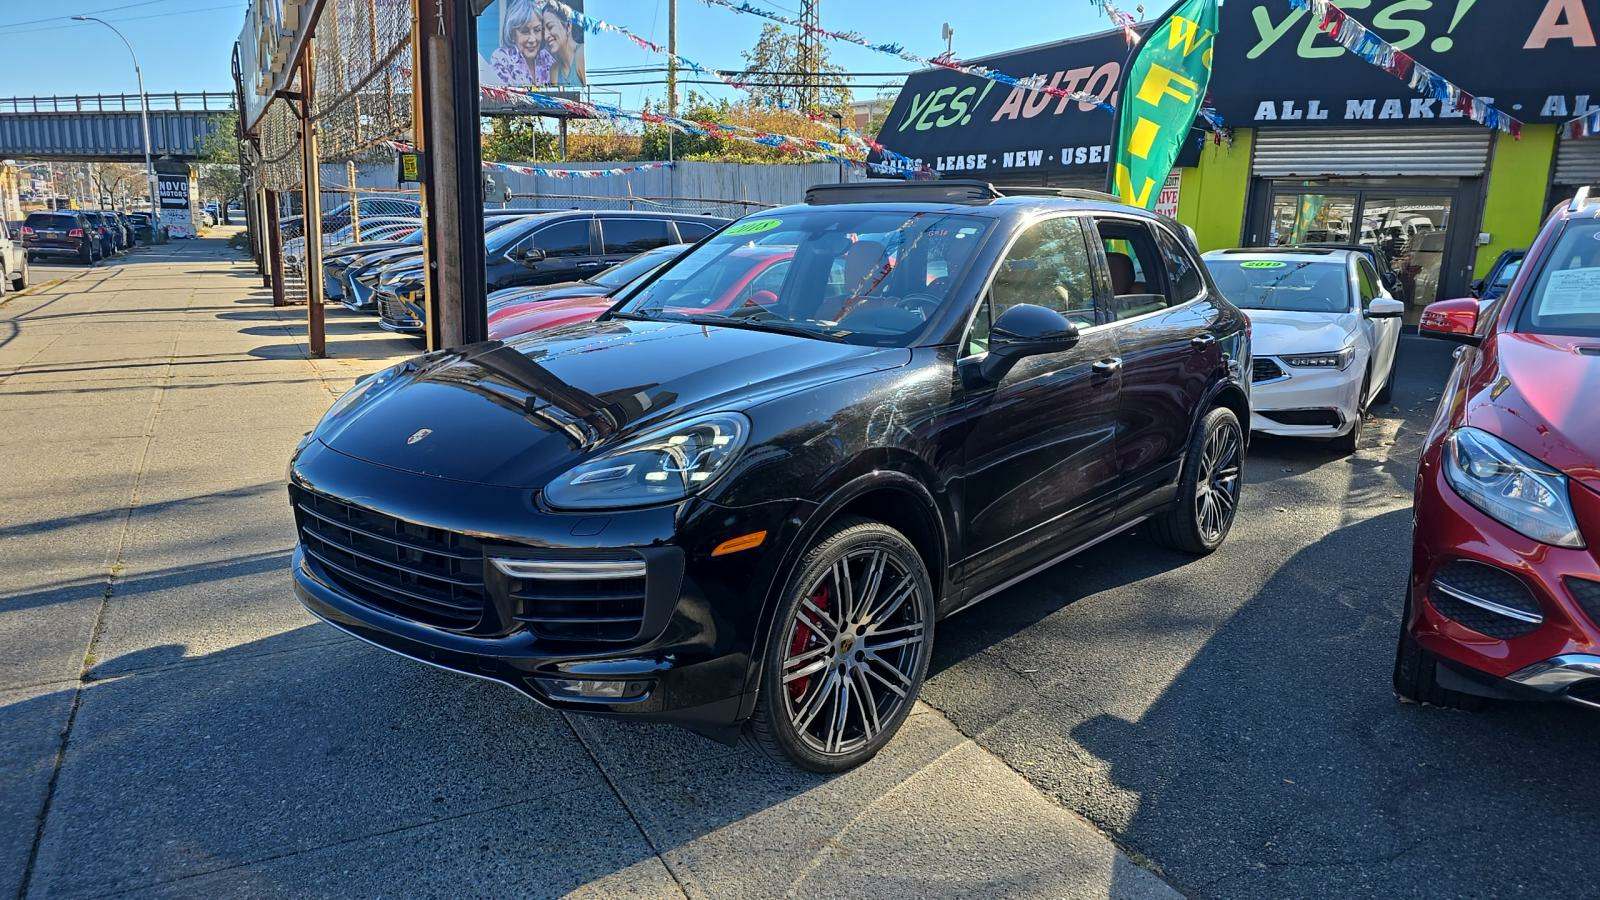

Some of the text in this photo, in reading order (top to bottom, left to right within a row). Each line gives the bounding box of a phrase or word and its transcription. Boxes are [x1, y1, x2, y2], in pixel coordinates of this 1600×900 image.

[1247, 0, 1478, 59] YES!
[898, 61, 1118, 132] YES! AUTO
[1254, 100, 1329, 120] ALL
[1344, 96, 1495, 120] MAKE
[936, 154, 987, 171] LEASE
[1002, 150, 1043, 168] NEW
[159, 181, 187, 190] NOVO
